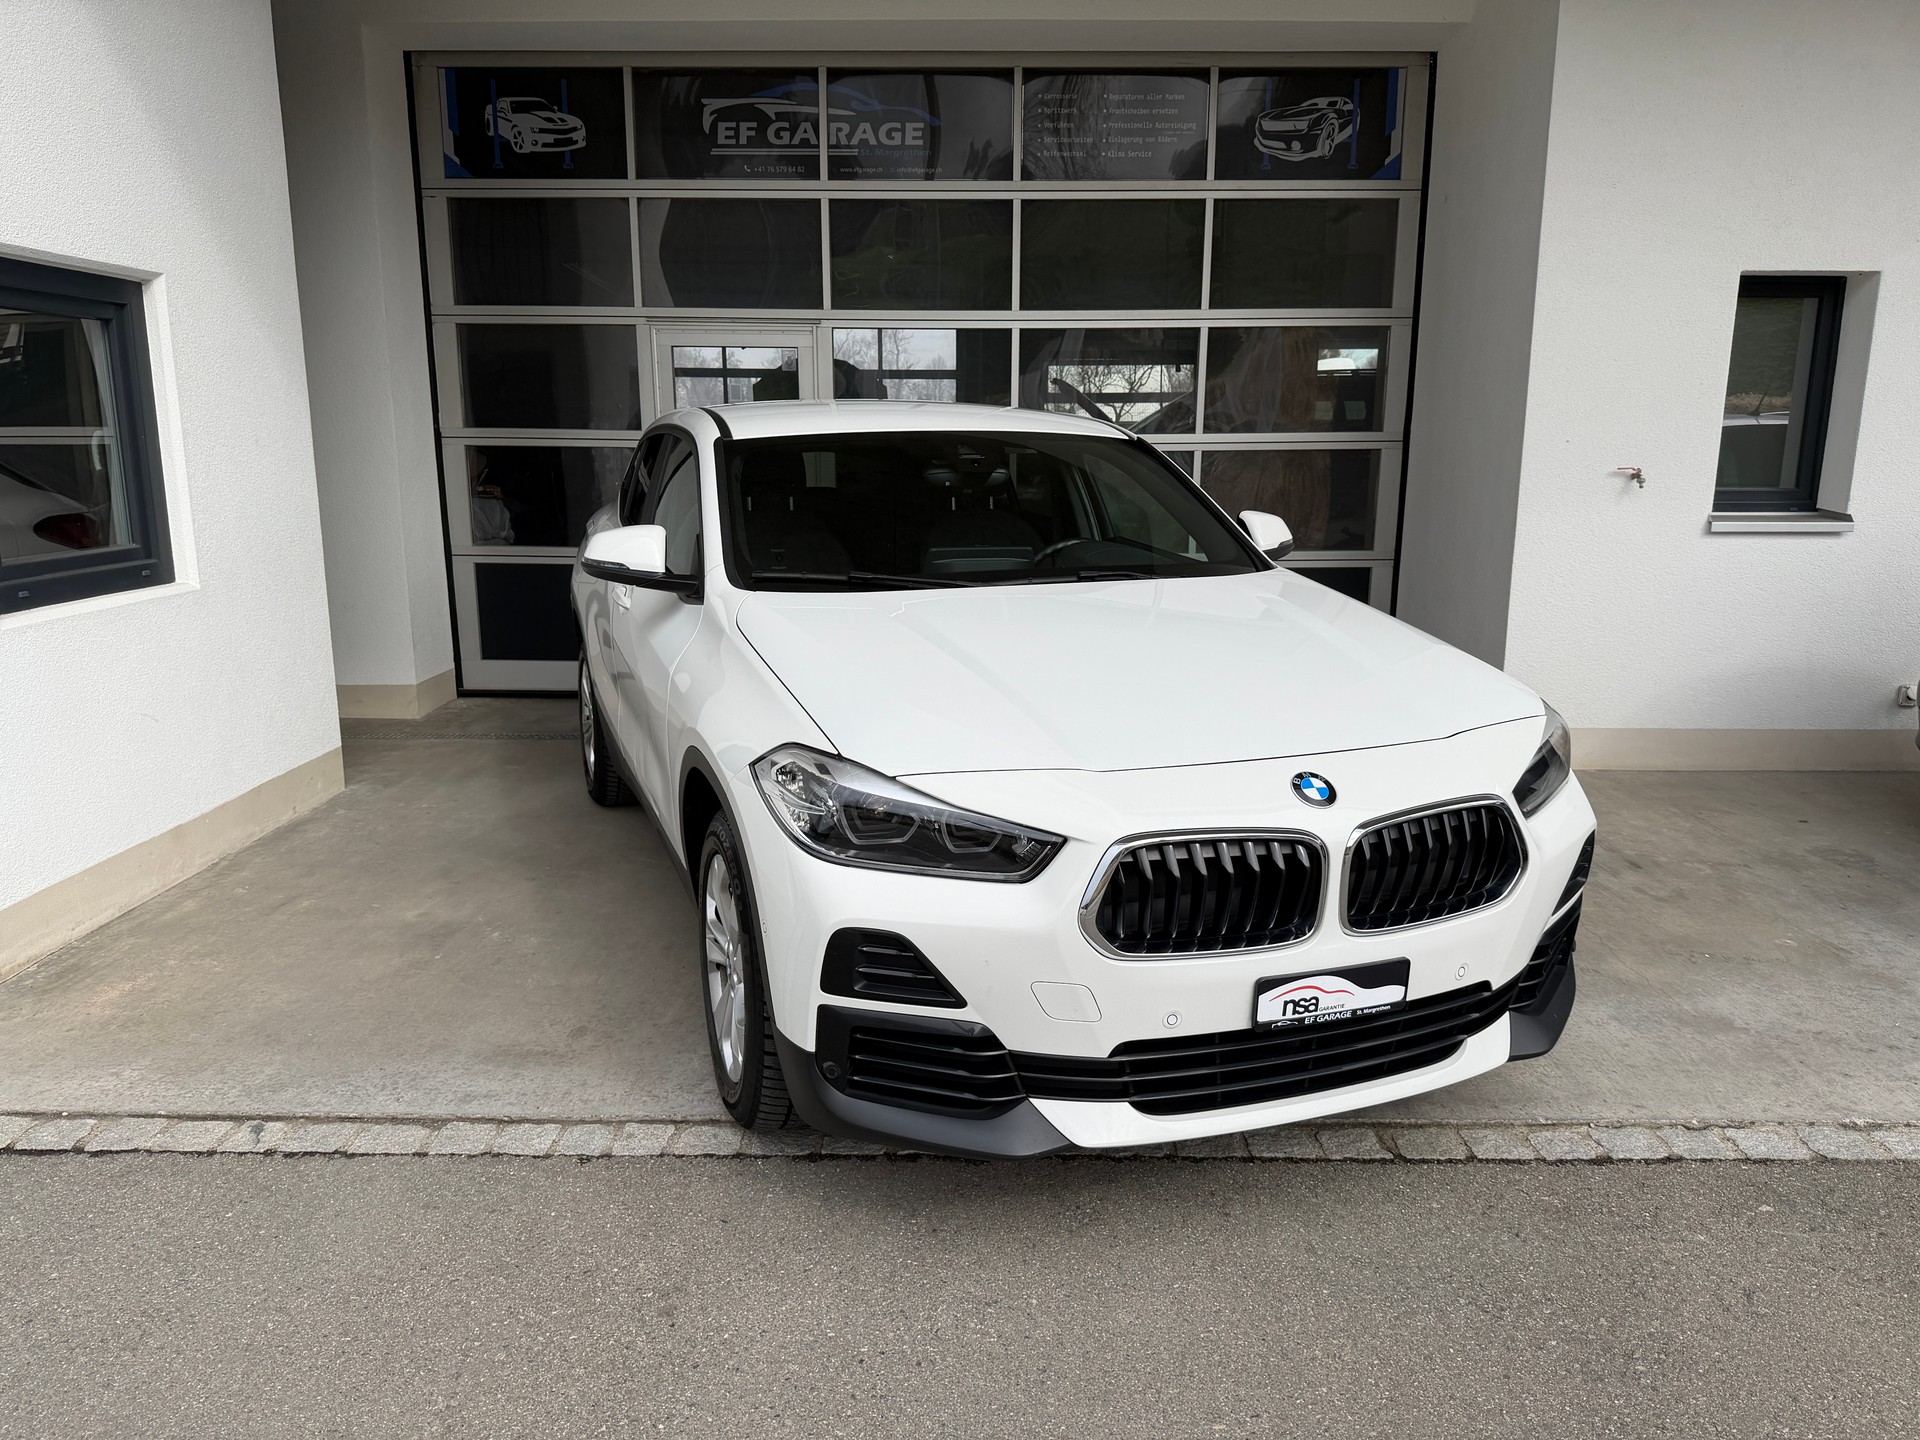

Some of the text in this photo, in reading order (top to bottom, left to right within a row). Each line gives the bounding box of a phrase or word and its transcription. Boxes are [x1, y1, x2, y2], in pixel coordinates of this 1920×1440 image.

[1109, 93, 1144, 101] Reparaturen
[1044, 106, 1077, 114] Spritzwerk
[1109, 121, 1196, 130] Professionelle Autoreinigung
[717, 121, 925, 146] EF GARAGE
[1108, 136, 1143, 144] Einlagerung
[1107, 150, 1152, 158] Klima Service
[767, 165, 775, 173] 76
[776, 165, 787, 173] 579
[788, 165, 796, 173] 64
[797, 165, 805, 173] 82
[1292, 772, 1326, 785] BMW
[1282, 996, 1320, 1017] nsa
[1319, 1003, 1345, 1012] GARANTIE
[1304, 1016, 1316, 1024] EF
[1316, 1010, 1352, 1022] GARAGE
